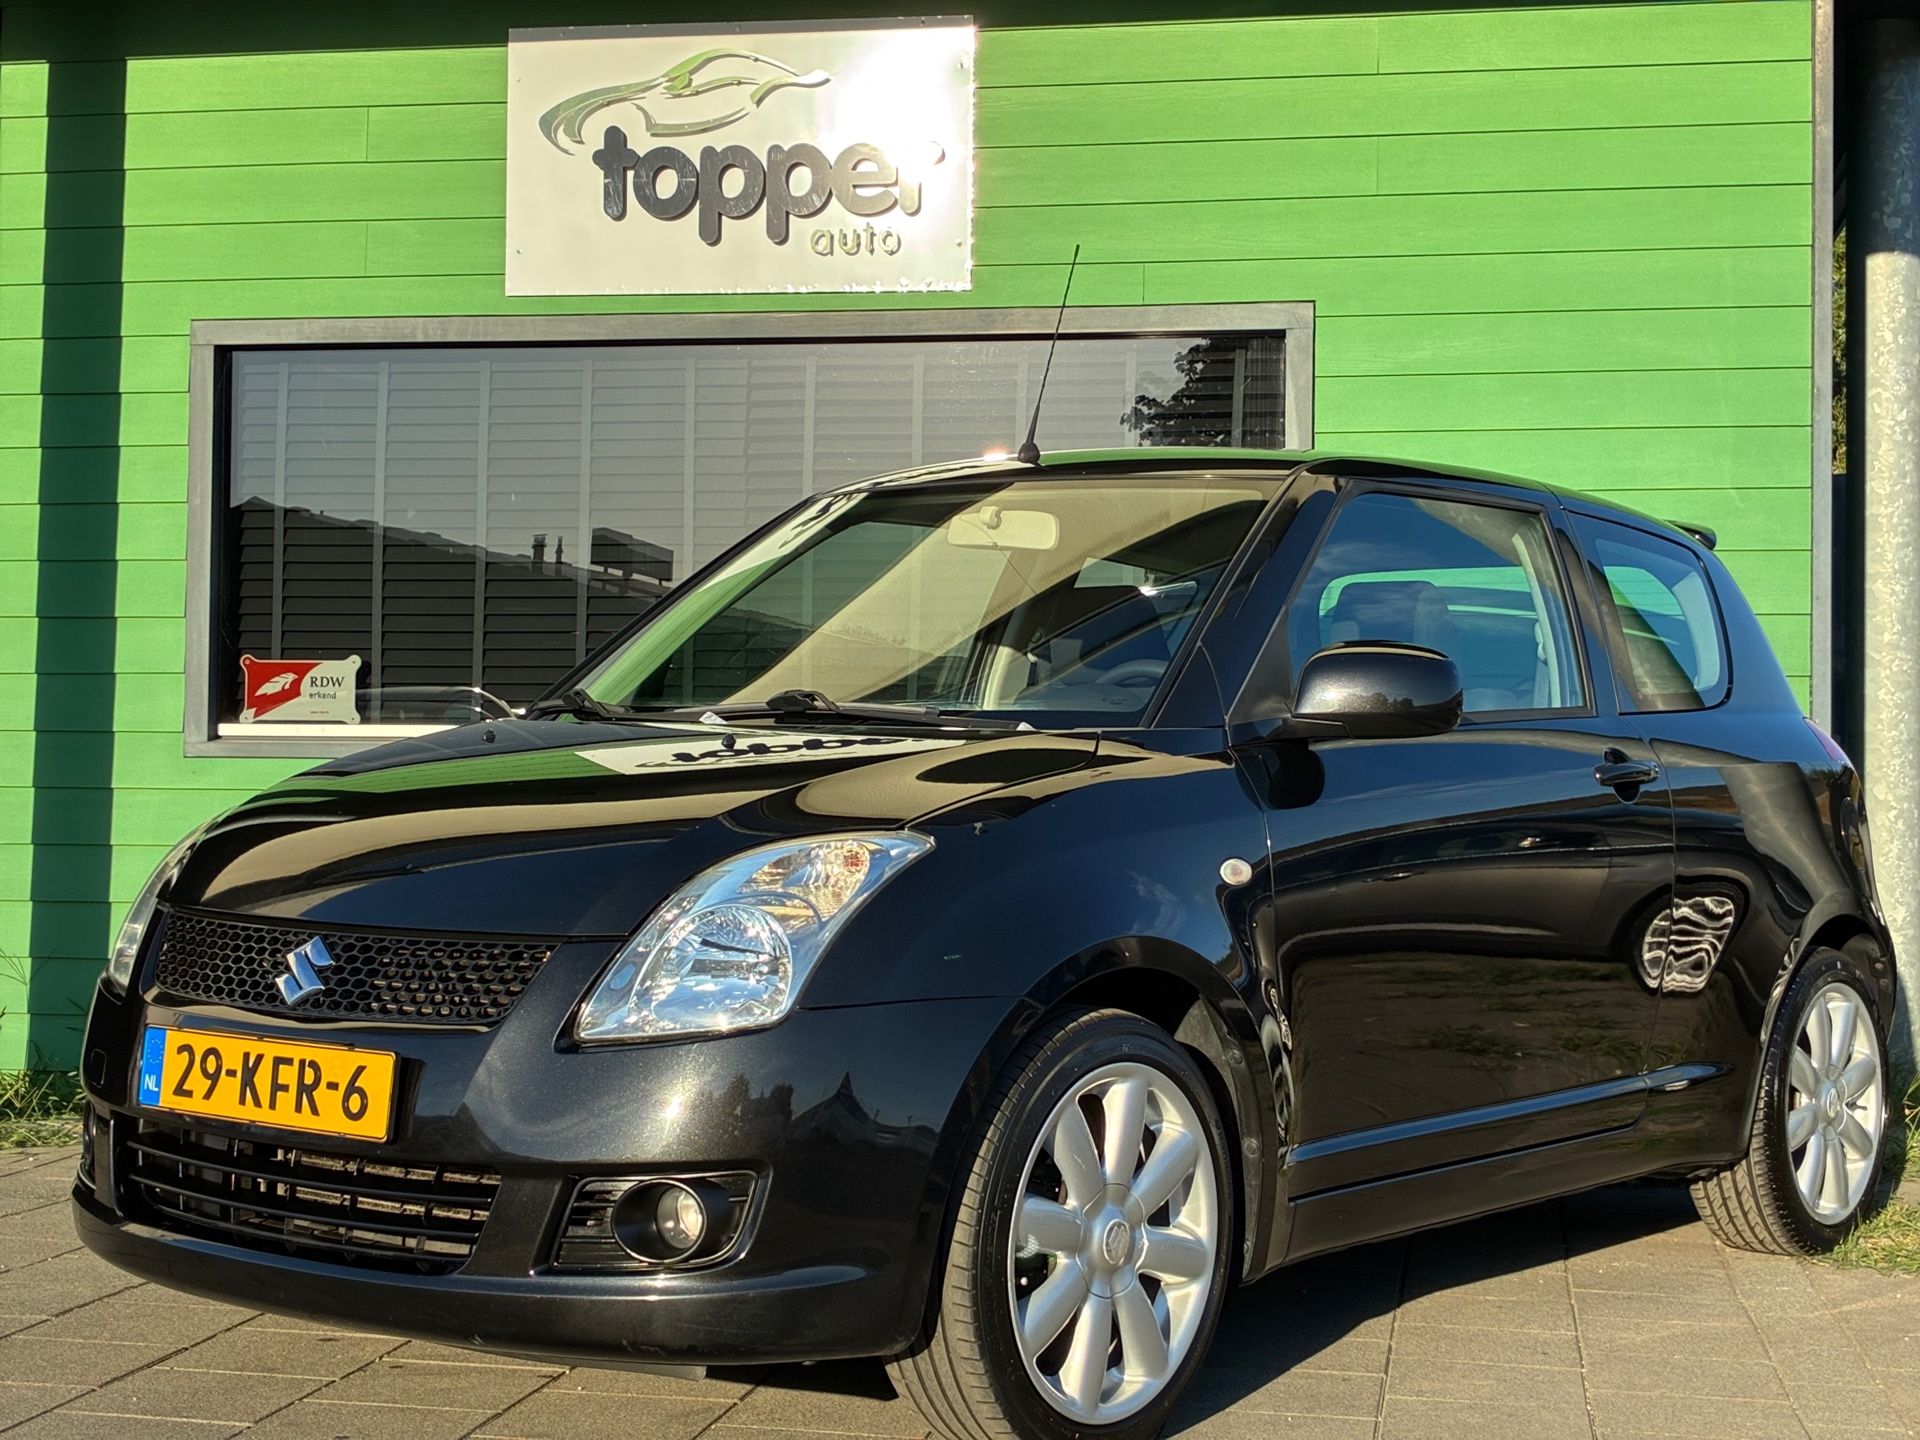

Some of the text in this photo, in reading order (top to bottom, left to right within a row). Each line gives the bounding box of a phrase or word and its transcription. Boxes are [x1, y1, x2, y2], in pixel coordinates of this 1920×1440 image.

[810, 221, 901, 257] auto
[310, 676, 345, 688] RDW
[309, 691, 337, 699] erkend
[144, 1073, 159, 1092] NL
[172, 1043, 368, 1122] 29-KFR-6
